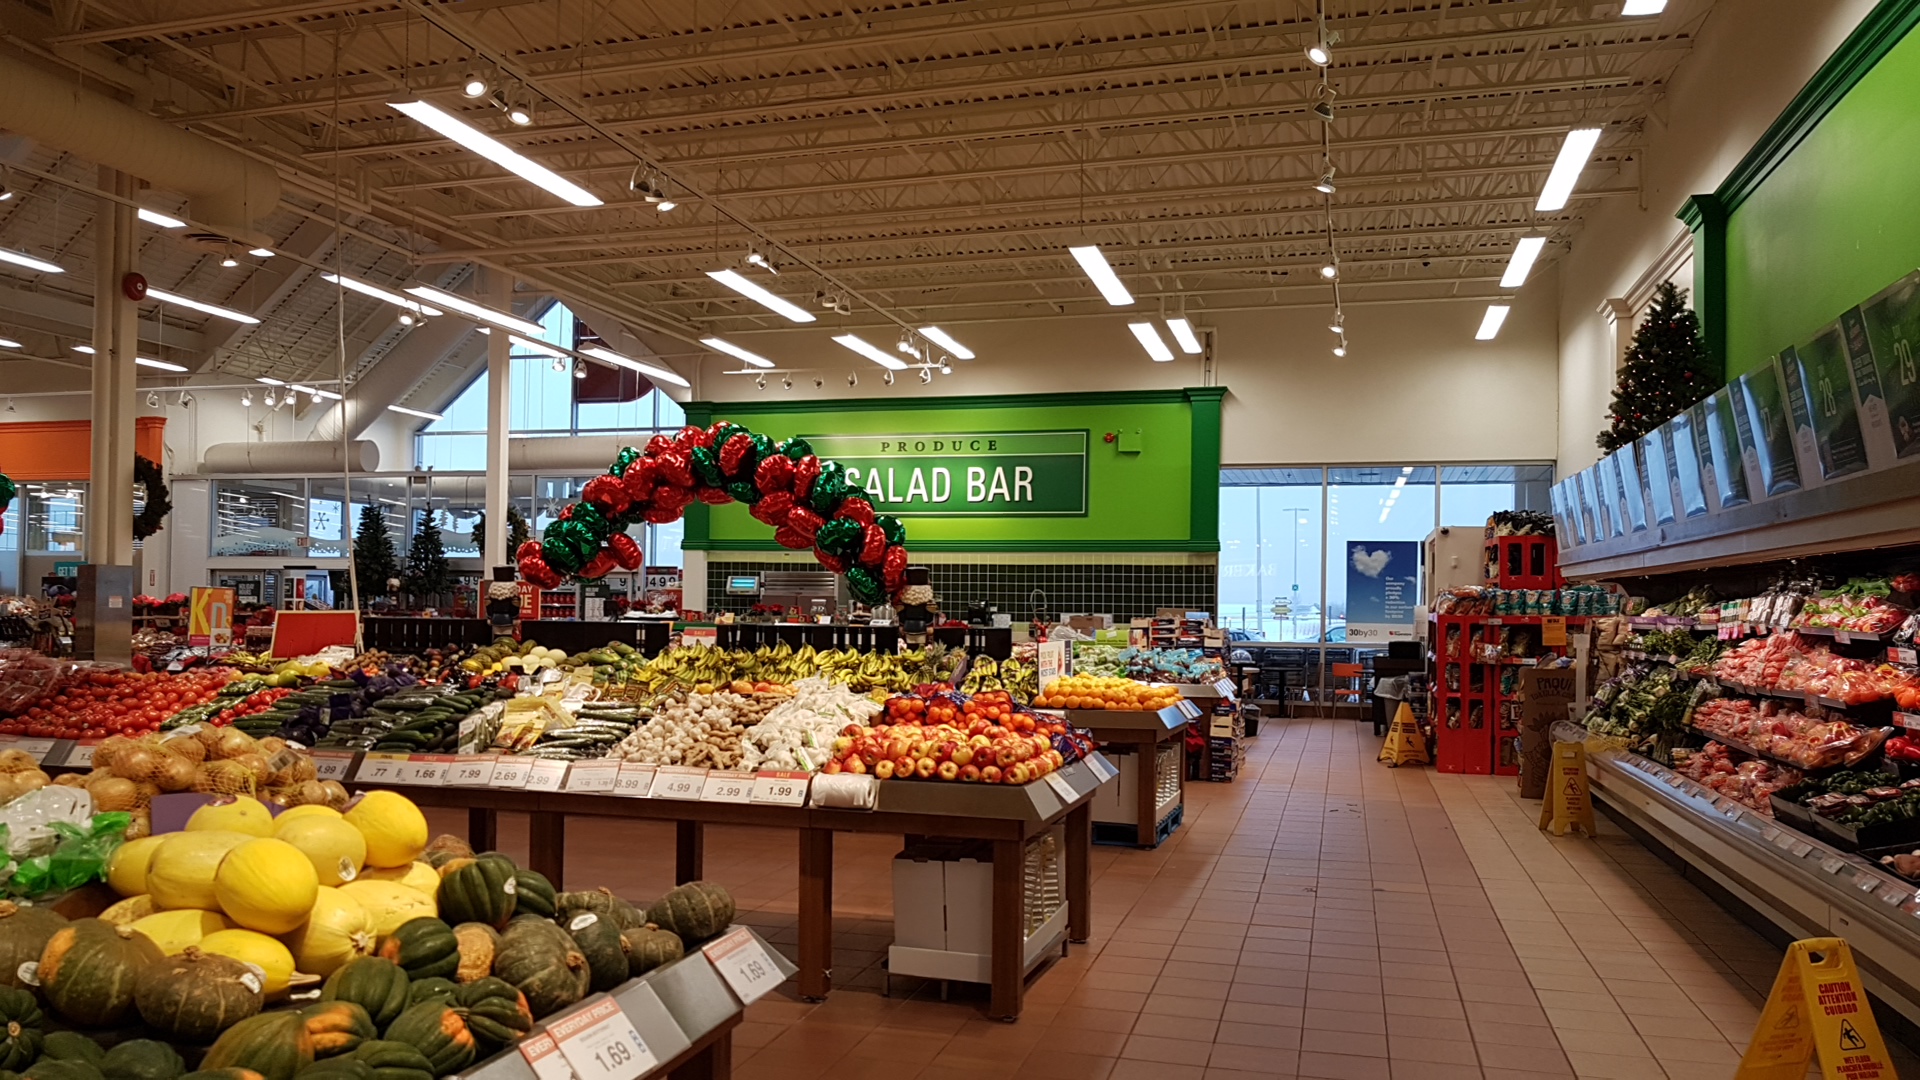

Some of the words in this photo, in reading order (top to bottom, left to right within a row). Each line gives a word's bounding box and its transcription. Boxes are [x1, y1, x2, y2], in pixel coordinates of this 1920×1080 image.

[1893, 338, 1917, 386] 29
[1819, 376, 1837, 417] 28
[881, 439, 998, 453] PRODUCE
[966, 466, 1034, 502] BAR
[1348, 629, 1378, 638] 30by30
[1537, 677, 1573, 691] PAQUI
[371, 768, 388, 777] .77
[414, 769, 437, 779] 1.66
[459, 769, 481, 779] 7.99
[494, 771, 518, 781] 2.69
[667, 783, 691, 793] 4.99
[716, 786, 741, 797] 2.99
[769, 786, 792, 797] 1.99
[739, 960, 766, 983] 1.69
[1818, 981, 1852, 994] CAUTION
[1818, 992, 1858, 1005] ATTENTION
[1824, 1003, 1858, 1016] CUIDADO
[554, 1013, 594, 1039] EVERYDAY
[594, 1040, 632, 1072] 1.69
